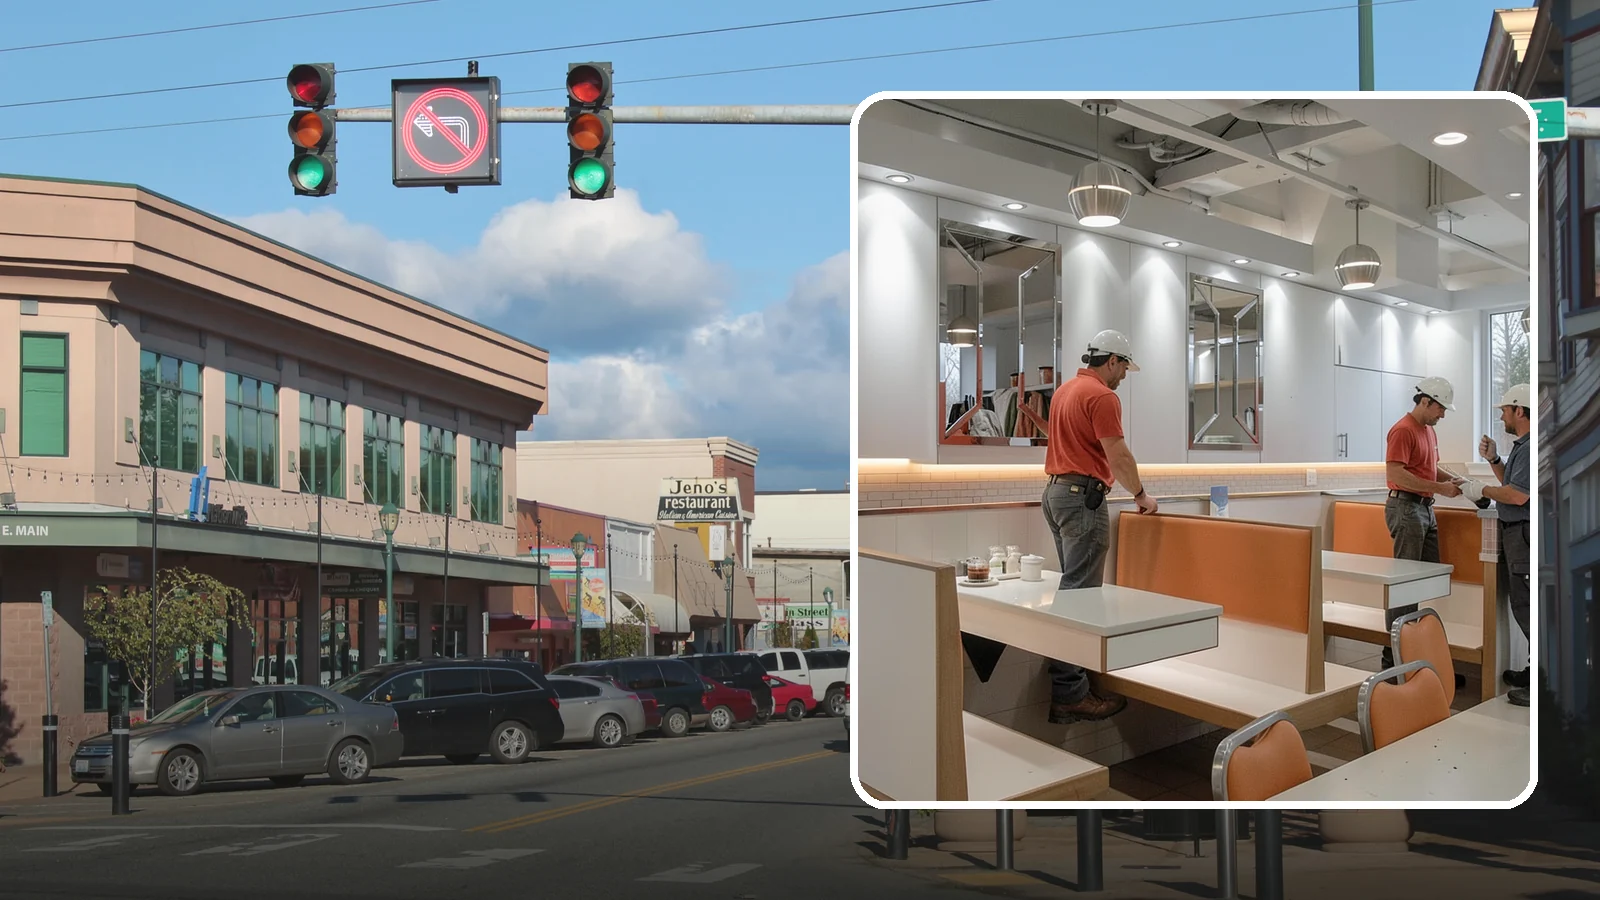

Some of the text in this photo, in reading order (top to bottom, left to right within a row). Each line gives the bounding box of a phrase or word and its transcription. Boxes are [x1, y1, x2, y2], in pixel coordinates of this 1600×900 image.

[670, 480, 727, 494] Jeno's
[665, 497, 731, 509] restaurant
[659, 510, 681, 519] Italian
[686, 510, 714, 519] American
[715, 510, 738, 519] Cuisine
[2, 525, 49, 536] E. MAIN
[797, 607, 828, 617] Street
